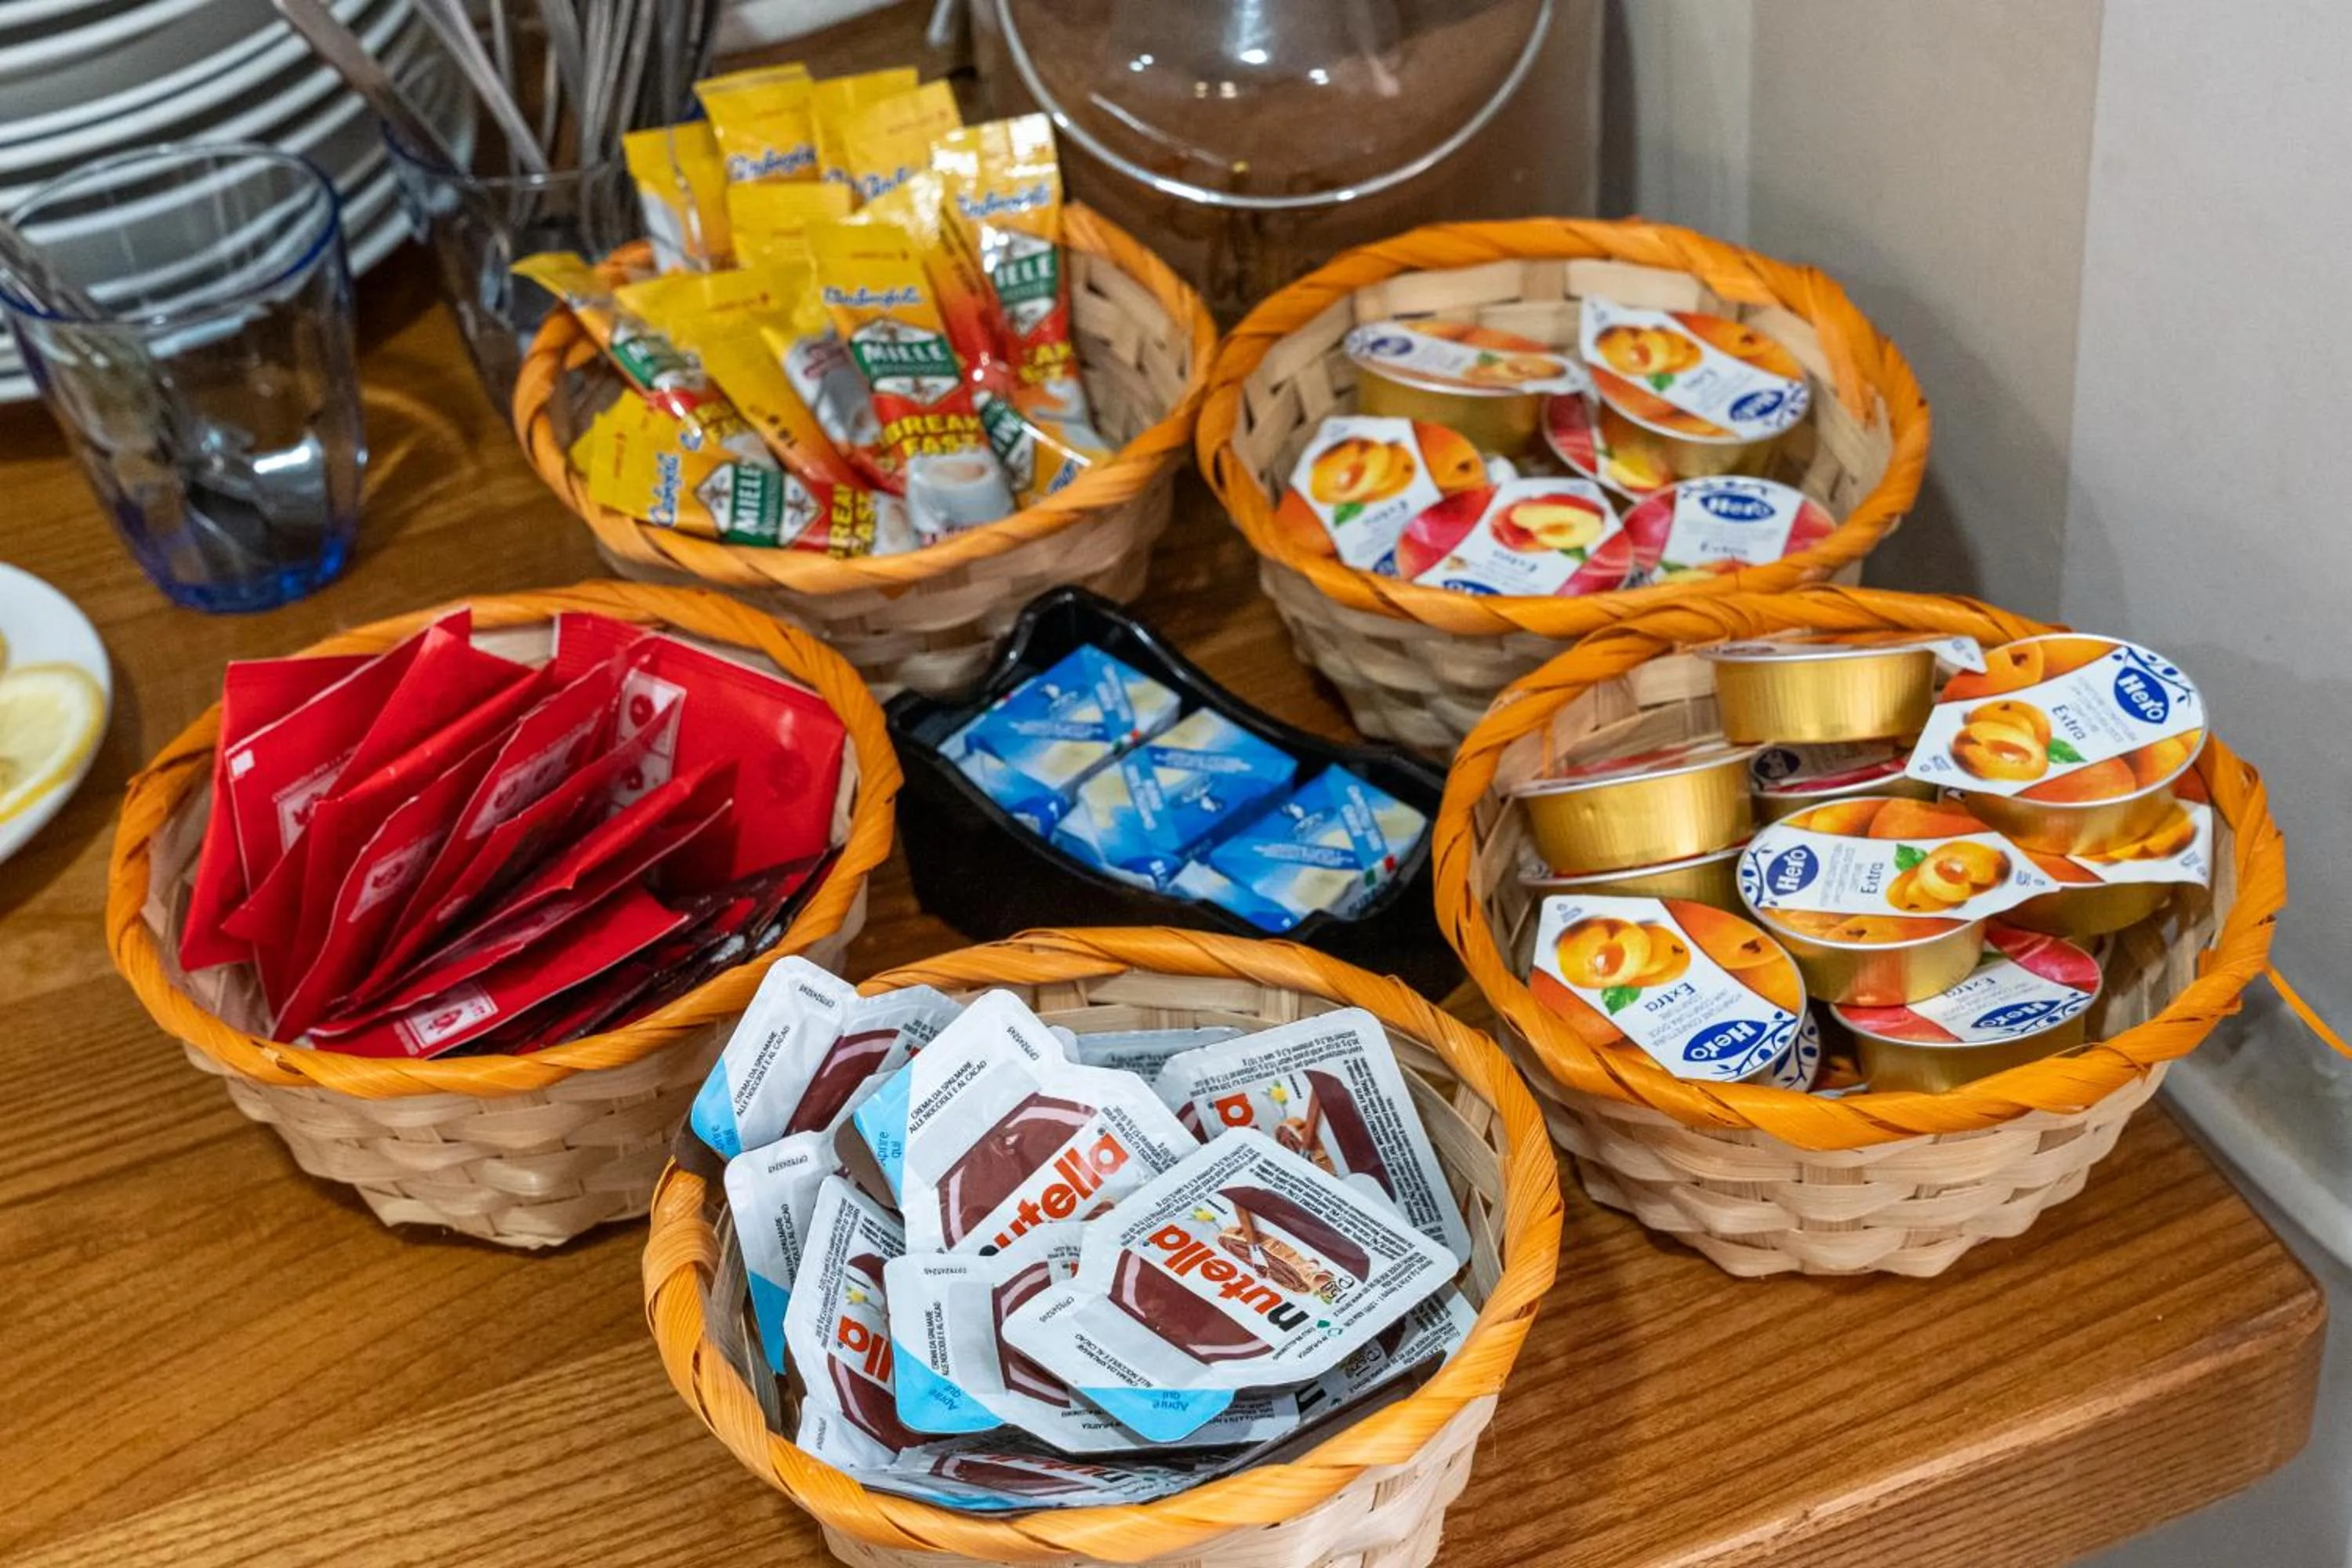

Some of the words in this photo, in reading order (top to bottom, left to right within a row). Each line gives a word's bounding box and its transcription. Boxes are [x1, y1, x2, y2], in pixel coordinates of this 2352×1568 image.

[2117, 673, 2165, 720] Hero
[2051, 703, 2087, 741] Extra
[1776, 848, 1808, 892] Hero
[1860, 862, 1886, 895] Extra
[1644, 982, 1697, 1013] Extra
[1979, 1001, 2049, 1029] Hero
[1690, 1021, 1759, 1059] Hero
[978, 1133, 1129, 1256] tella
[1147, 1224, 1311, 1331] nutella
